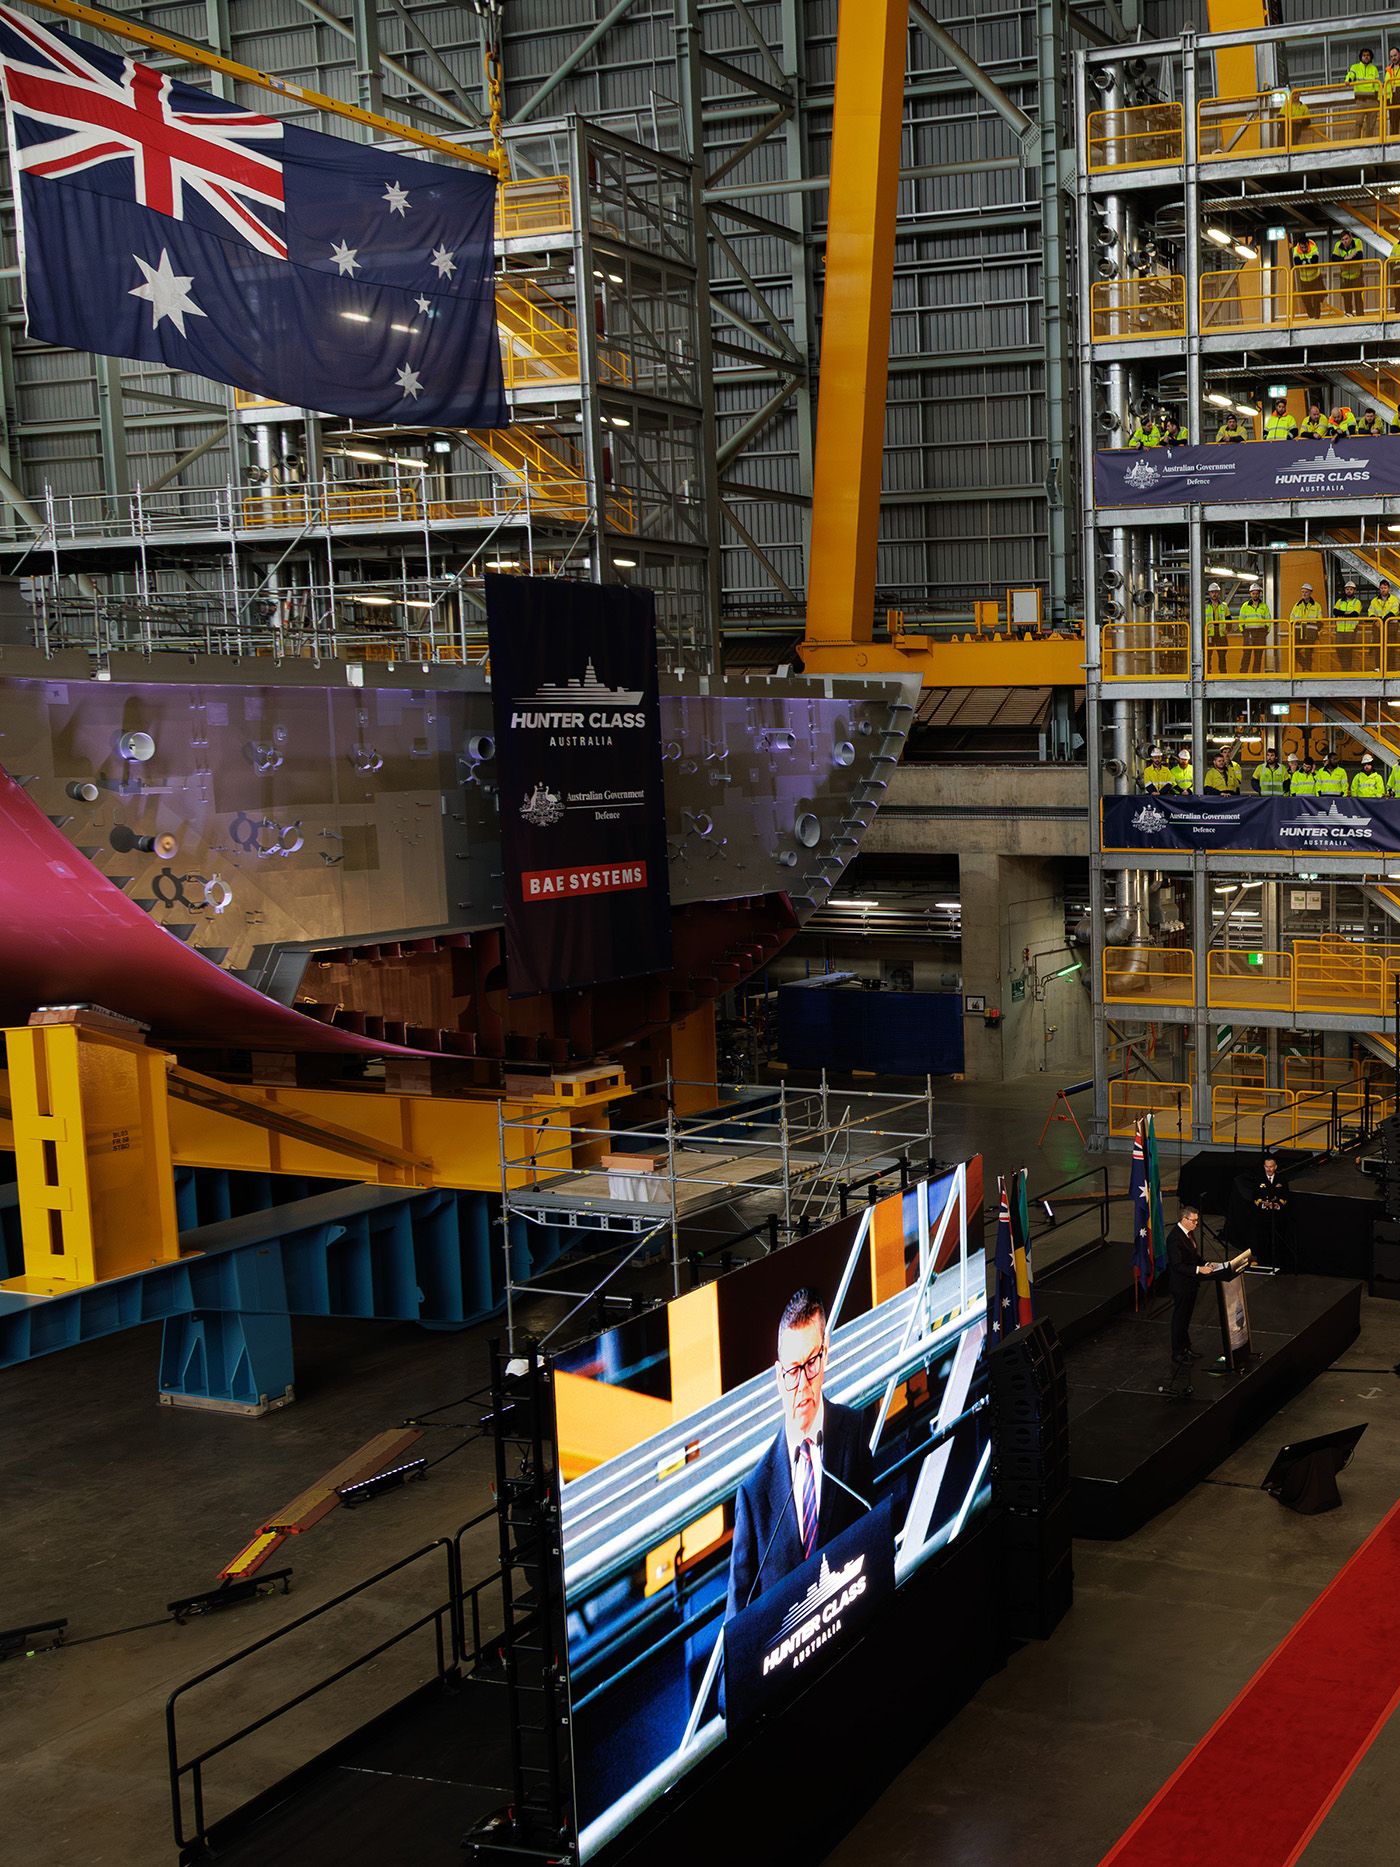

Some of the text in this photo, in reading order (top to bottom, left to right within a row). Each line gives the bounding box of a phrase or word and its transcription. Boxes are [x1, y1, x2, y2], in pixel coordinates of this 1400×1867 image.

[1162, 462, 1236, 473] Australian Government
[1275, 471, 1370, 484] HUNTER CLASS
[1300, 484, 1345, 492] AUSTRALIA
[511, 712, 646, 729] HUNTER CLASS
[550, 736, 613, 747] AUSTRALIA
[566, 789, 644, 802] Australian Government
[595, 811, 620, 821] Defence
[1169, 812, 1241, 821] Australian Government
[1192, 826, 1216, 834] Defence
[1280, 827, 1373, 838] HUNTER CLASS
[529, 867, 642, 895] BAE SYSTEMS
[762, 1575, 868, 1676] HUNTER CLASS
[792, 1619, 842, 1669] AUSTRALIA
